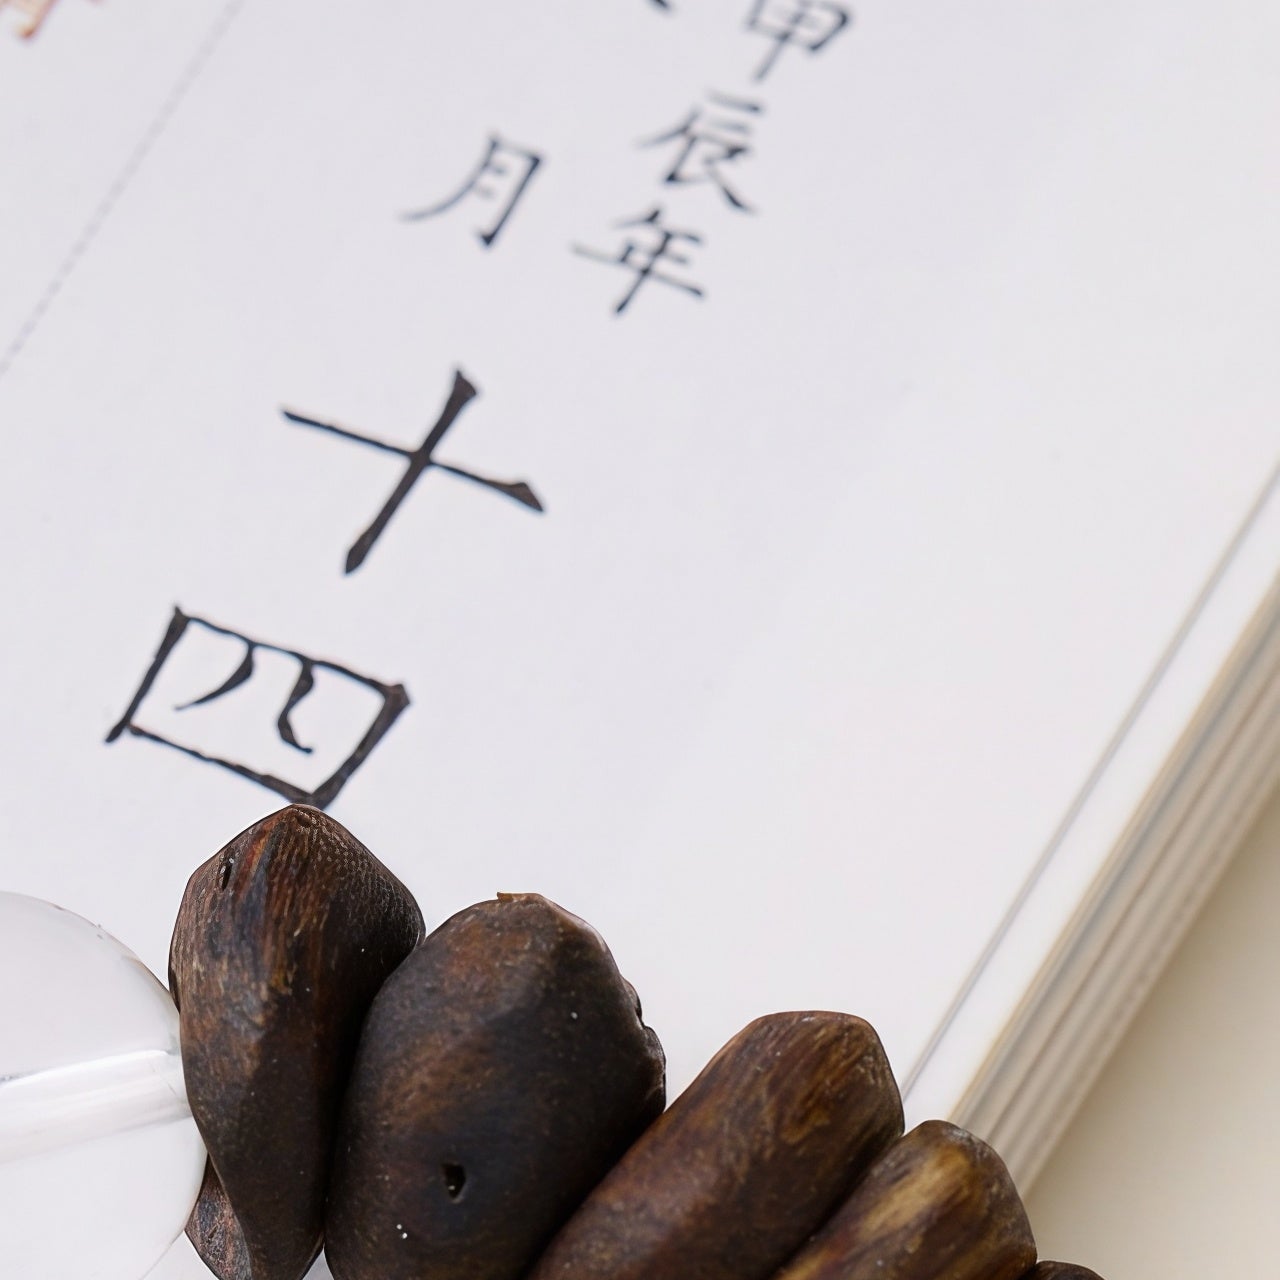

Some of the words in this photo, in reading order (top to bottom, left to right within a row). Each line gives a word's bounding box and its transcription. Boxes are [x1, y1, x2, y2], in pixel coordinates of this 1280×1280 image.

[392, 134, 548, 251] 月
[569, 0, 854, 319] 甲辰年
[104, 364, 548, 810] 十四
